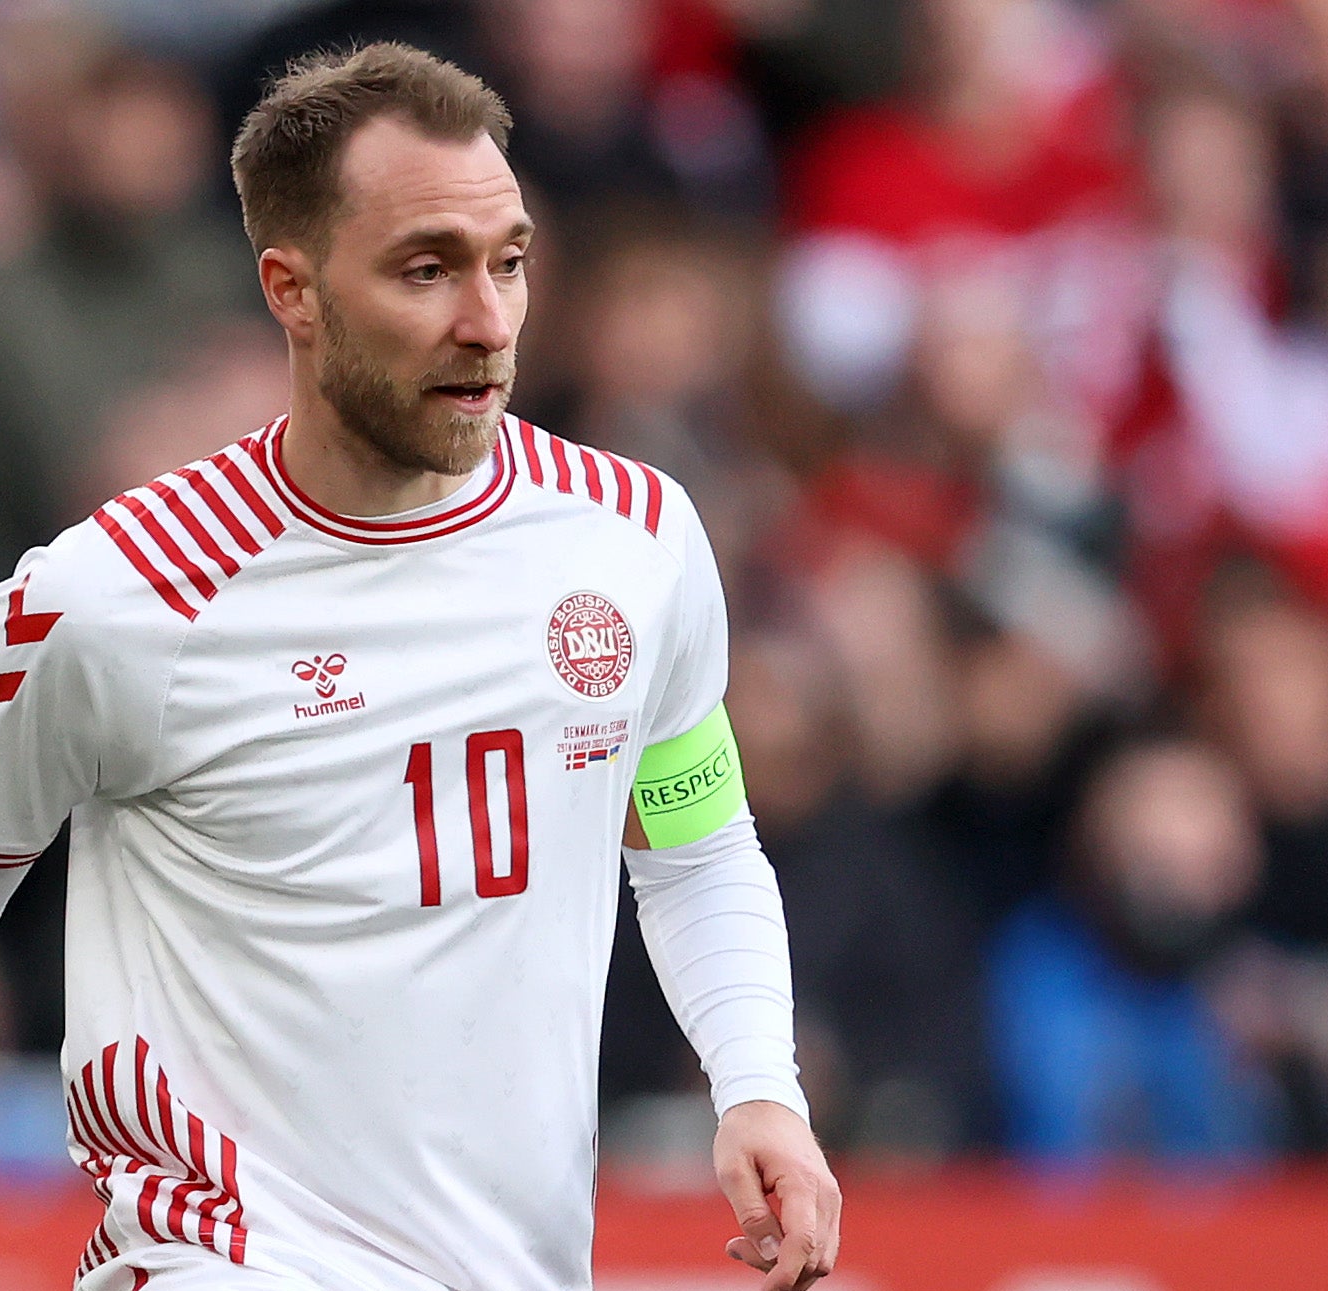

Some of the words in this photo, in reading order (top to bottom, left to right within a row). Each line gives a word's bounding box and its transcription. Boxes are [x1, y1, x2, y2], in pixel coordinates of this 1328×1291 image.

[549, 626, 578, 687] DANSK
[583, 680, 616, 696] 1889
[564, 627, 617, 660] DBU
[294, 692, 365, 718] hummel
[564, 724, 599, 739] DENMARK
[641, 747, 730, 808] RESPECT
[404, 728, 529, 907] 10
